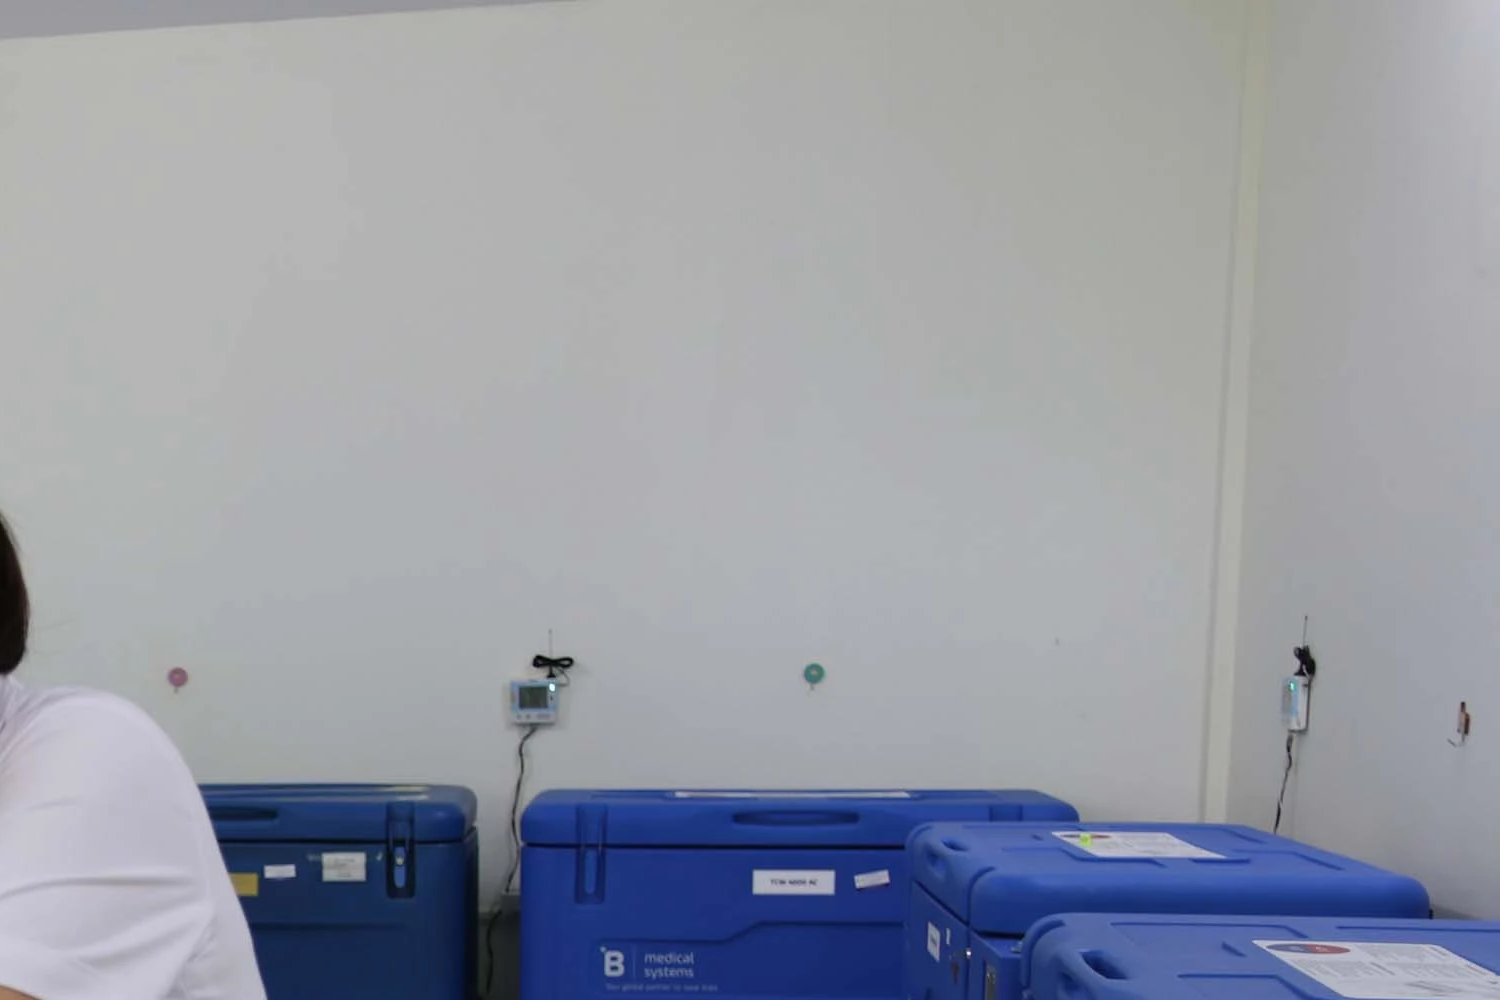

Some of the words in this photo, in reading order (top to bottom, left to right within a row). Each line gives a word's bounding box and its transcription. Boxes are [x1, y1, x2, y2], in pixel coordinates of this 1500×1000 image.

[604, 950, 625, 977] B
[644, 952, 694, 964] medical
[644, 966, 694, 980] systems
